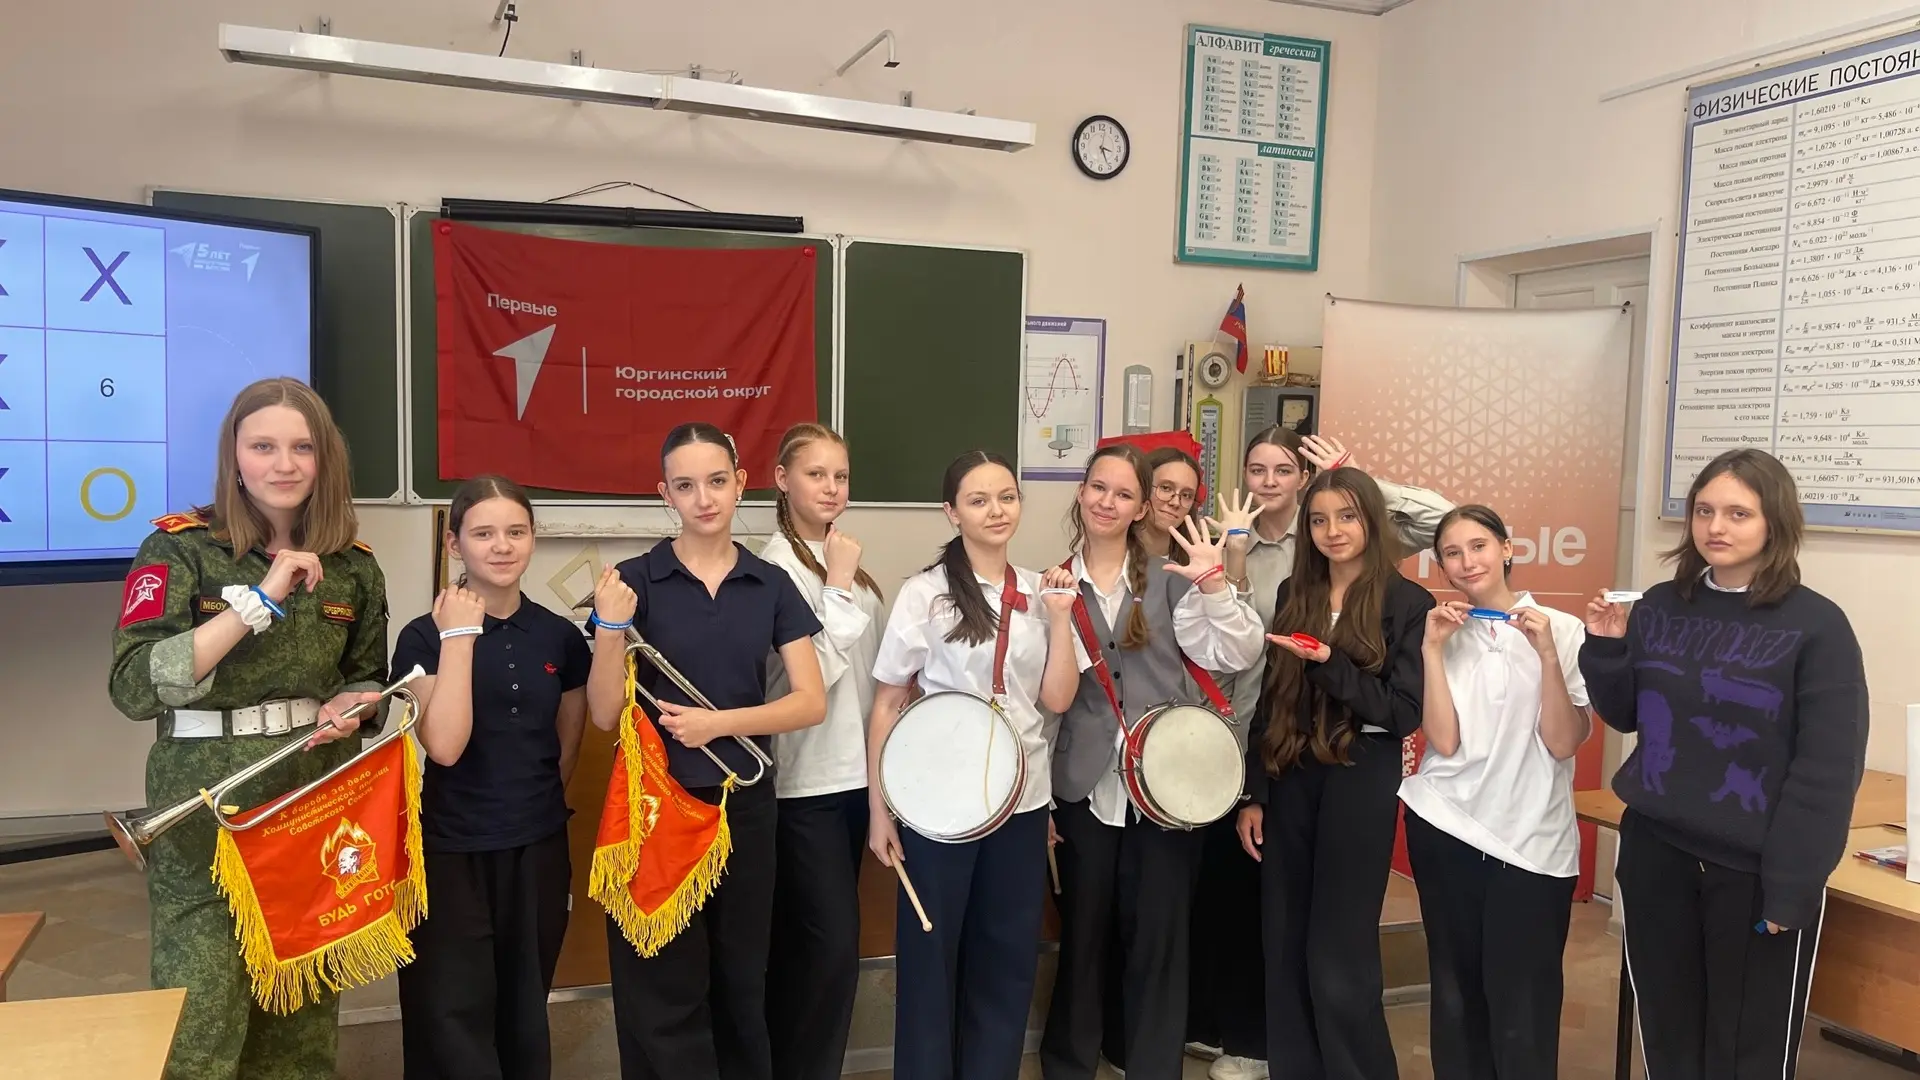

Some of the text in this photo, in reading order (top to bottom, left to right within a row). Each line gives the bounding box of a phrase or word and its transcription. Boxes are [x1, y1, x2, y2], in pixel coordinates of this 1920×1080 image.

[1196, 35, 1262, 54] АЛФАВИТ
[1269, 45, 1317, 58] греческий
[1693, 74, 1819, 119] ФИЗИЧЕСКИЕ
[1811, 104, 1836, 117] 1,60219
[1090, 125, 1096, 133] 11
[1098, 123, 1106, 132] 12
[1879, 127, 1906, 139] 1,00728
[1082, 132, 1090, 140] 10
[1114, 135, 1120, 143] 2
[1081, 142, 1086, 150] 9
[1260, 145, 1314, 158] латинский
[1813, 159, 1835, 170] 1,6749
[1877, 146, 1904, 158] 1,00867
[1098, 164, 1103, 172] 6
[1807, 197, 1826, 207] 6,672
[1806, 217, 1825, 227] 8,854
[197, 243, 209, 258] 5
[1801, 274, 1820, 284] 6,626
[1818, 289, 1836, 299] 1,055
[487, 292, 558, 317] Первые
[1826, 342, 1845, 351] 8,187
[1826, 362, 1844, 370] 1,503
[1891, 358, 1916, 366] 938,26
[615, 366, 727, 382] Юргинский
[100, 378, 115, 398] 6
[1825, 381, 1843, 390] 1,505
[1890, 378, 1915, 387] 939,55
[615, 384, 772, 401] городской округ
[1800, 412, 1818, 420] 1,759
[1813, 434, 1832, 443] 9,648
[1813, 474, 1839, 482] 1,66057
[1882, 476, 1915, 484] 931,5016
[203, 600, 228, 610] МБОУ
[278, 811, 288, 821] К
[331, 785, 345, 795] за
[346, 770, 372, 787] дело
[262, 789, 356, 838] Коммунистической
[289, 805, 345, 836] Советского
[318, 903, 357, 927] БУДЬ
